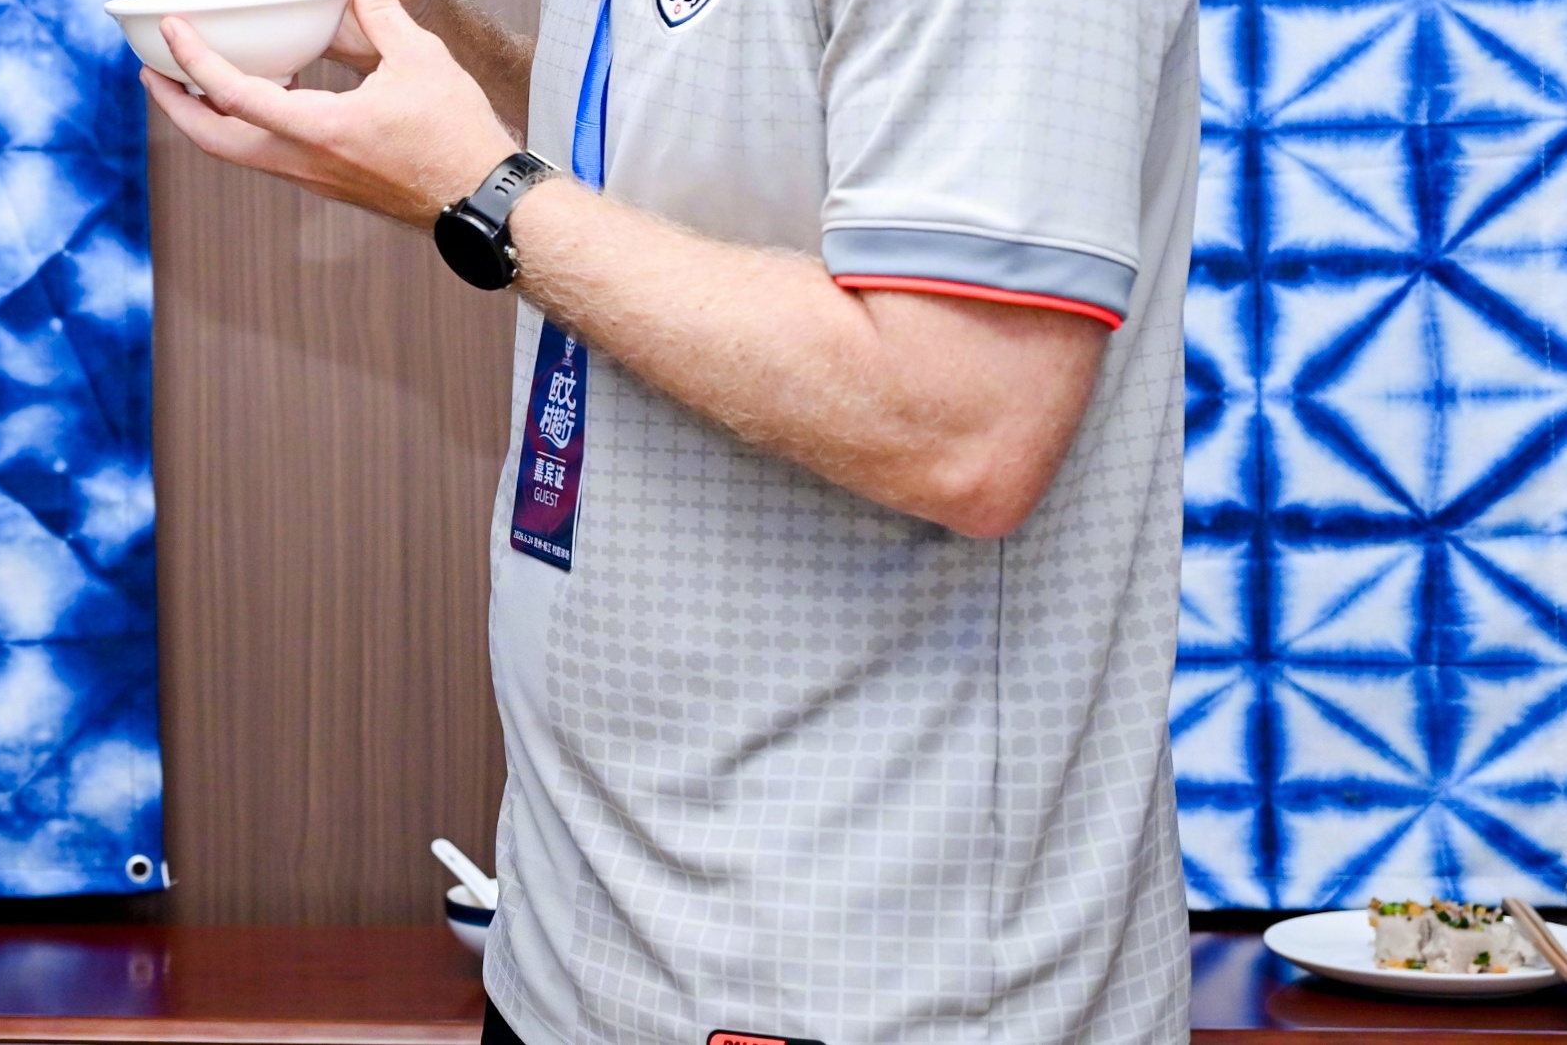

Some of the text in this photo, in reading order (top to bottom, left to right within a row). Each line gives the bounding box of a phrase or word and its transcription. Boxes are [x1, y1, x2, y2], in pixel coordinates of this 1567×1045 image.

[548, 370, 577, 410] 欧文
[533, 457, 565, 490] 嘉宾证
[533, 486, 560, 508] GUEST
